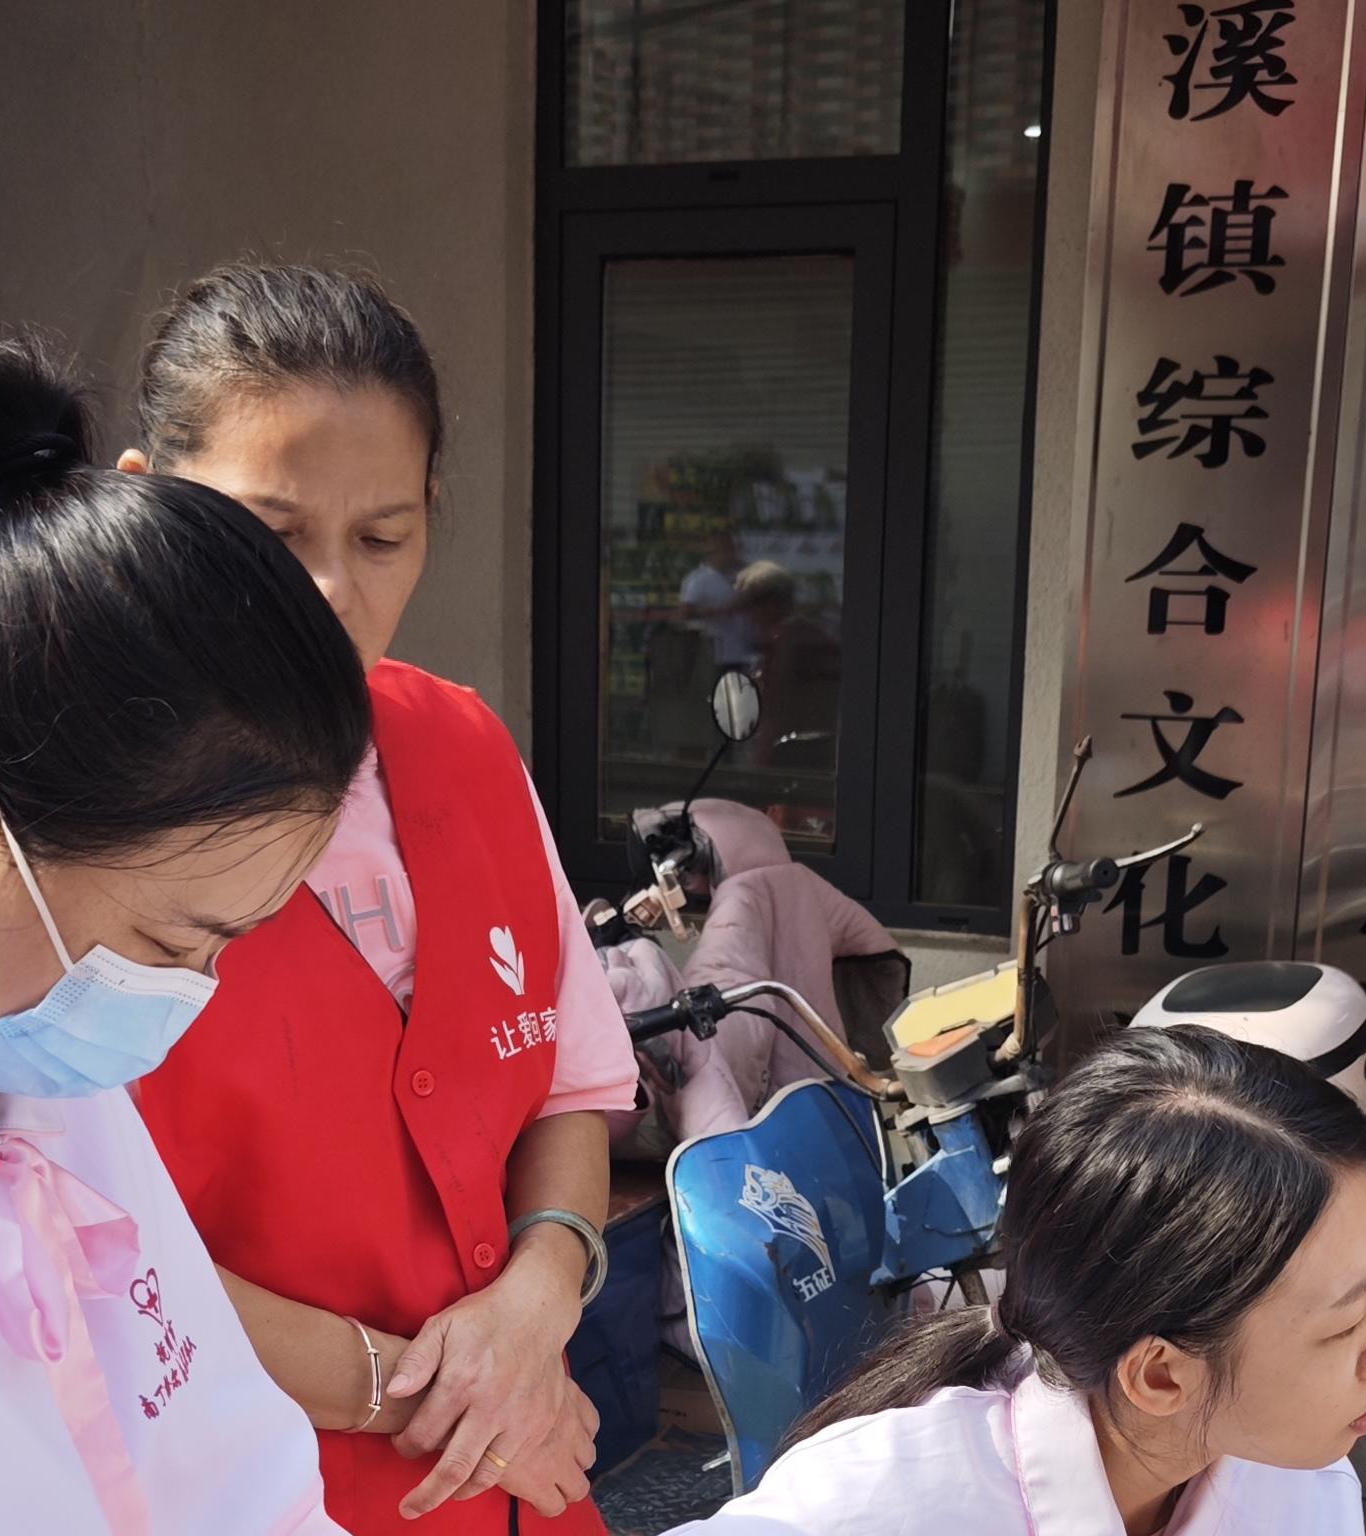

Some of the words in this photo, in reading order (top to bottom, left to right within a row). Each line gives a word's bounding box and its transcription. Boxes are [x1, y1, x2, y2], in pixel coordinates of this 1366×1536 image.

[1099, 2, 1299, 1022] 溪镇综合文化
[793, 1267, 833, 1303] 五征
